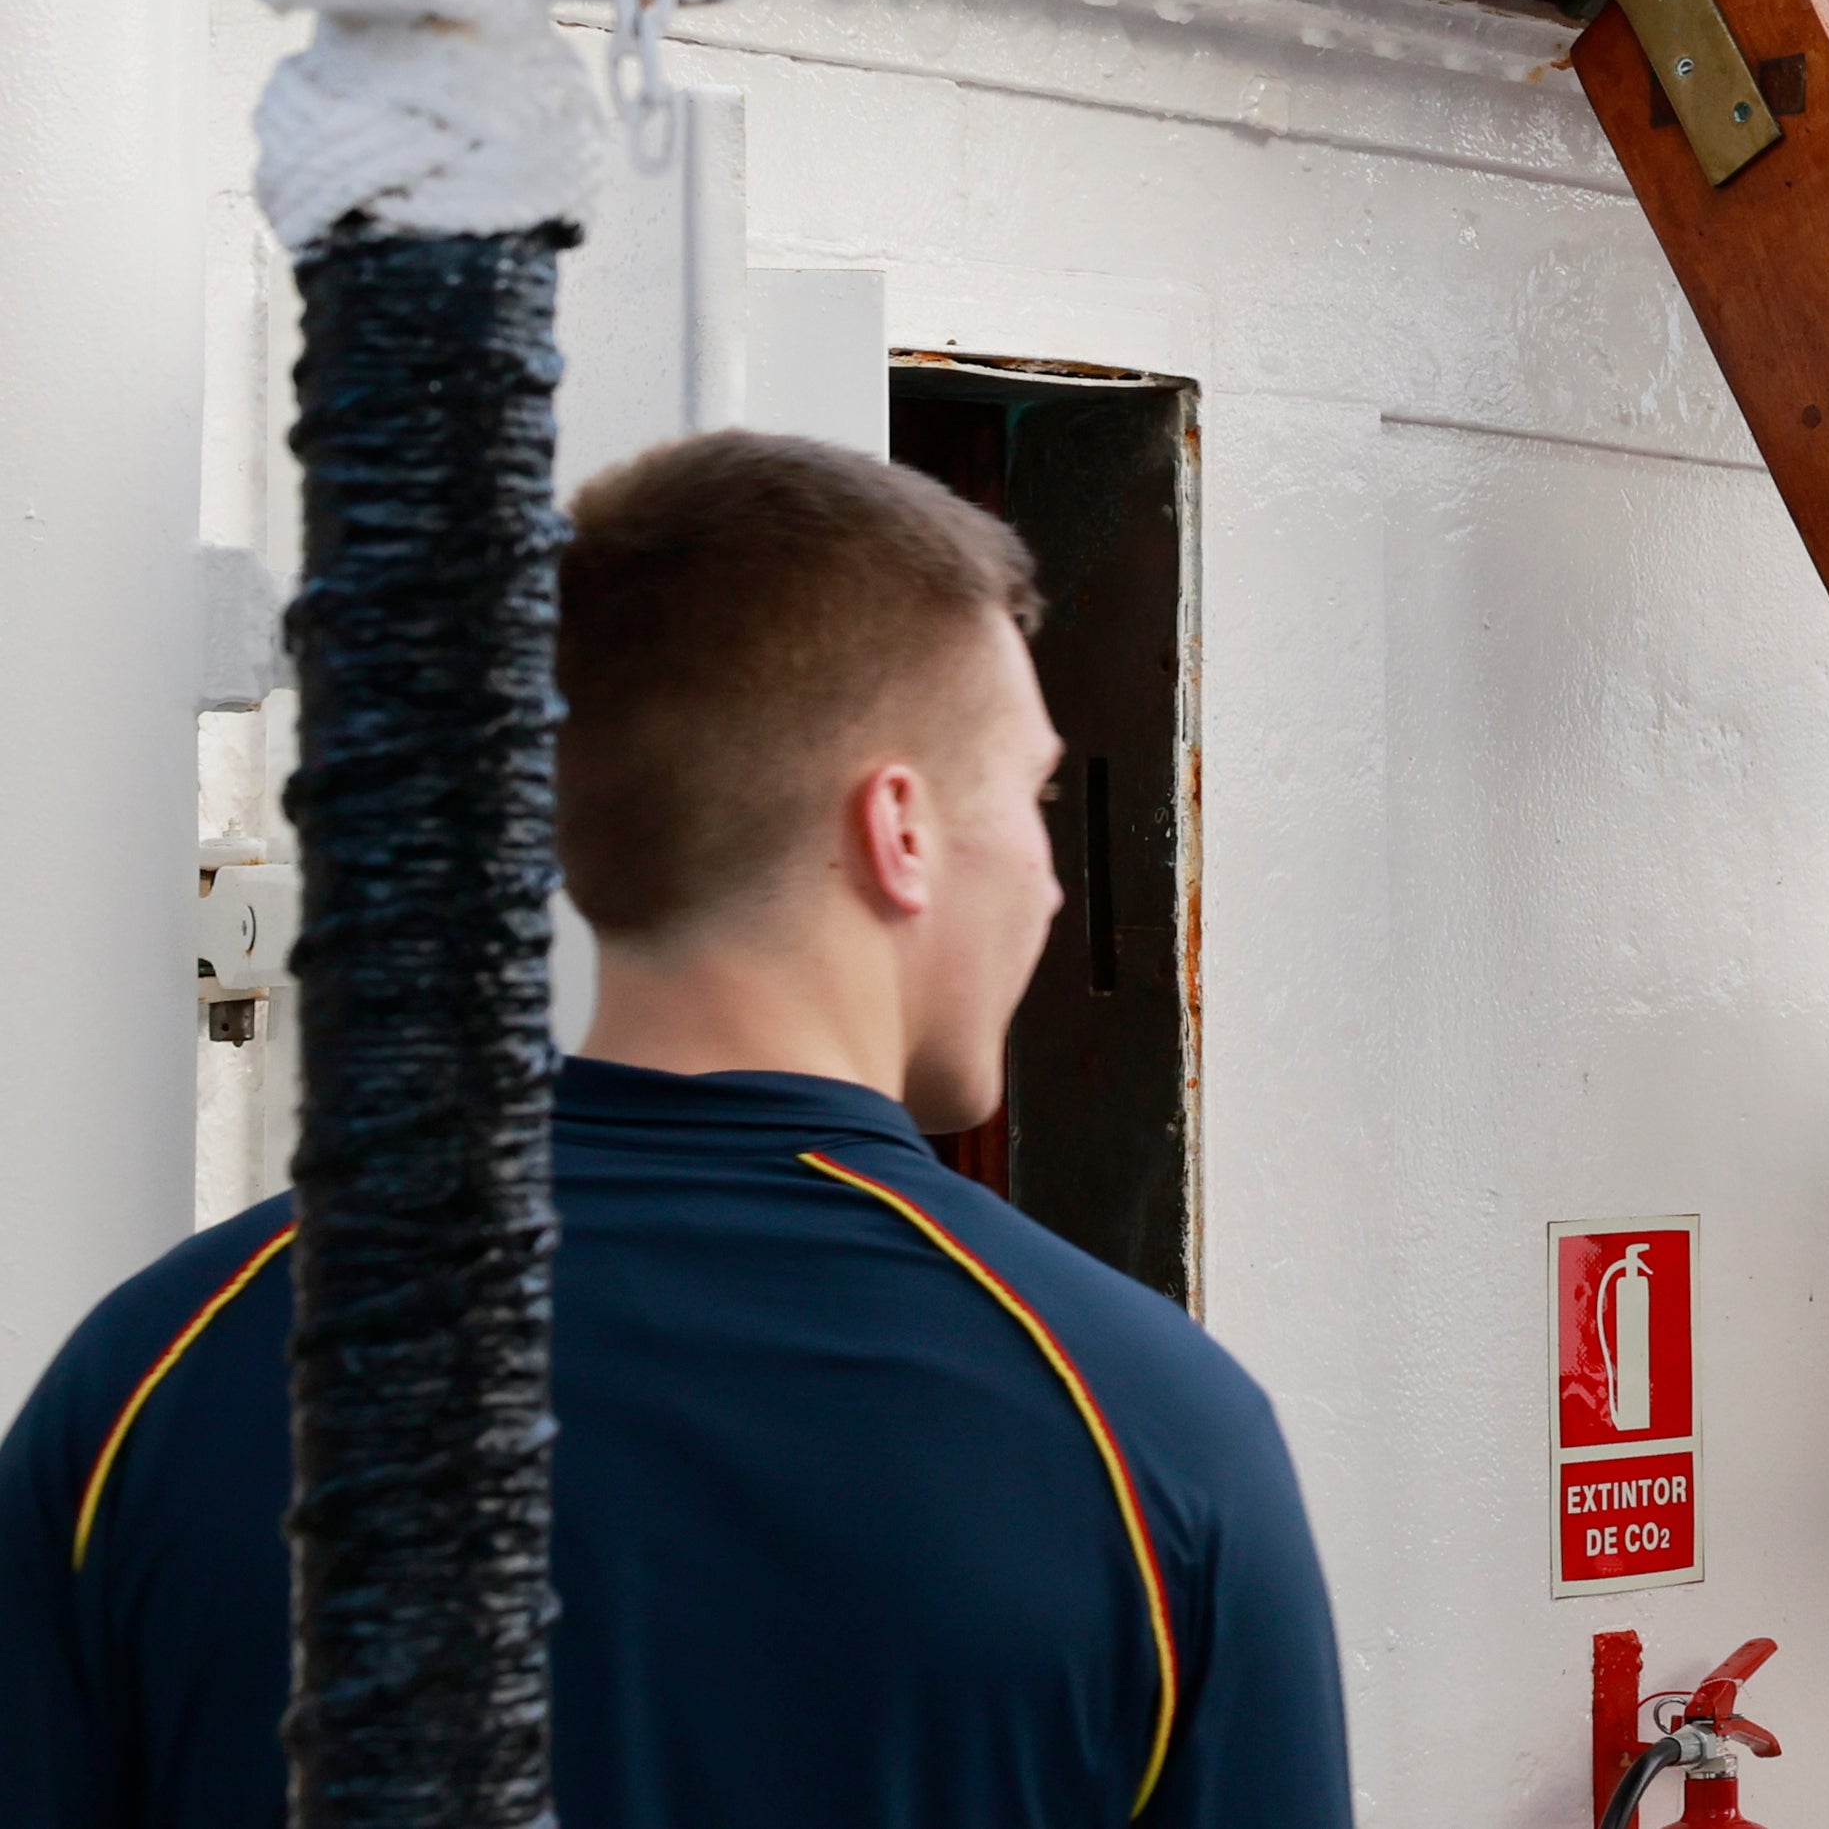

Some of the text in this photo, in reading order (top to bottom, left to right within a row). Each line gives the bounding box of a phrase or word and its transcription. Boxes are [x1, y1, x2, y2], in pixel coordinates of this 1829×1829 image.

[1567, 1475, 1687, 1514] EXTINTOR
[1586, 1521, 1671, 1557] DE CO2
